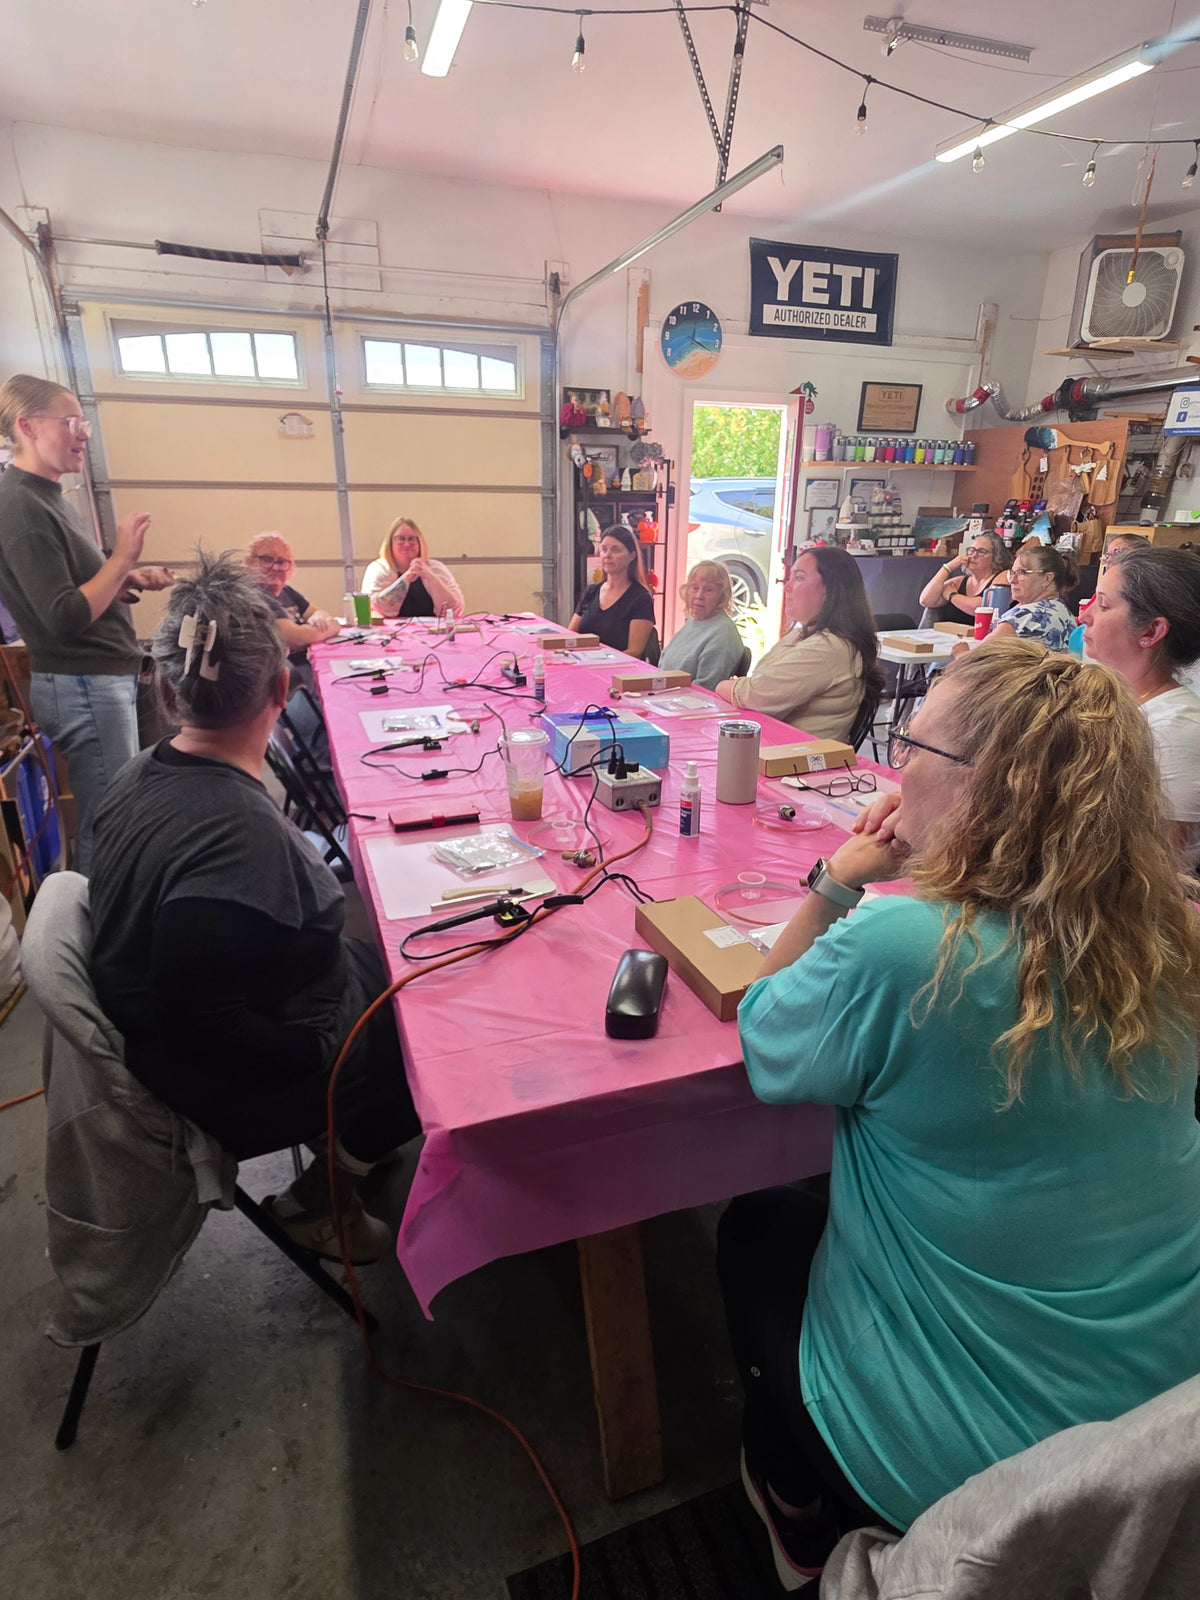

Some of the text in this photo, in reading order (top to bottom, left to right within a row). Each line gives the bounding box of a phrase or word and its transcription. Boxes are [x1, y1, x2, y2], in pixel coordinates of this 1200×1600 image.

[766, 256, 876, 309] YETI
[679, 305, 687, 315] 11
[692, 303, 700, 313] 12
[706, 309, 711, 319] 1
[773, 308, 867, 329] AUTHORIZED DEALER
[668, 315, 677, 325] 10
[712, 322, 719, 332] 2
[664, 331, 670, 341] 9
[714, 339, 720, 348] 3
[666, 347, 672, 357] 8
[881, 390, 902, 399] YETI
